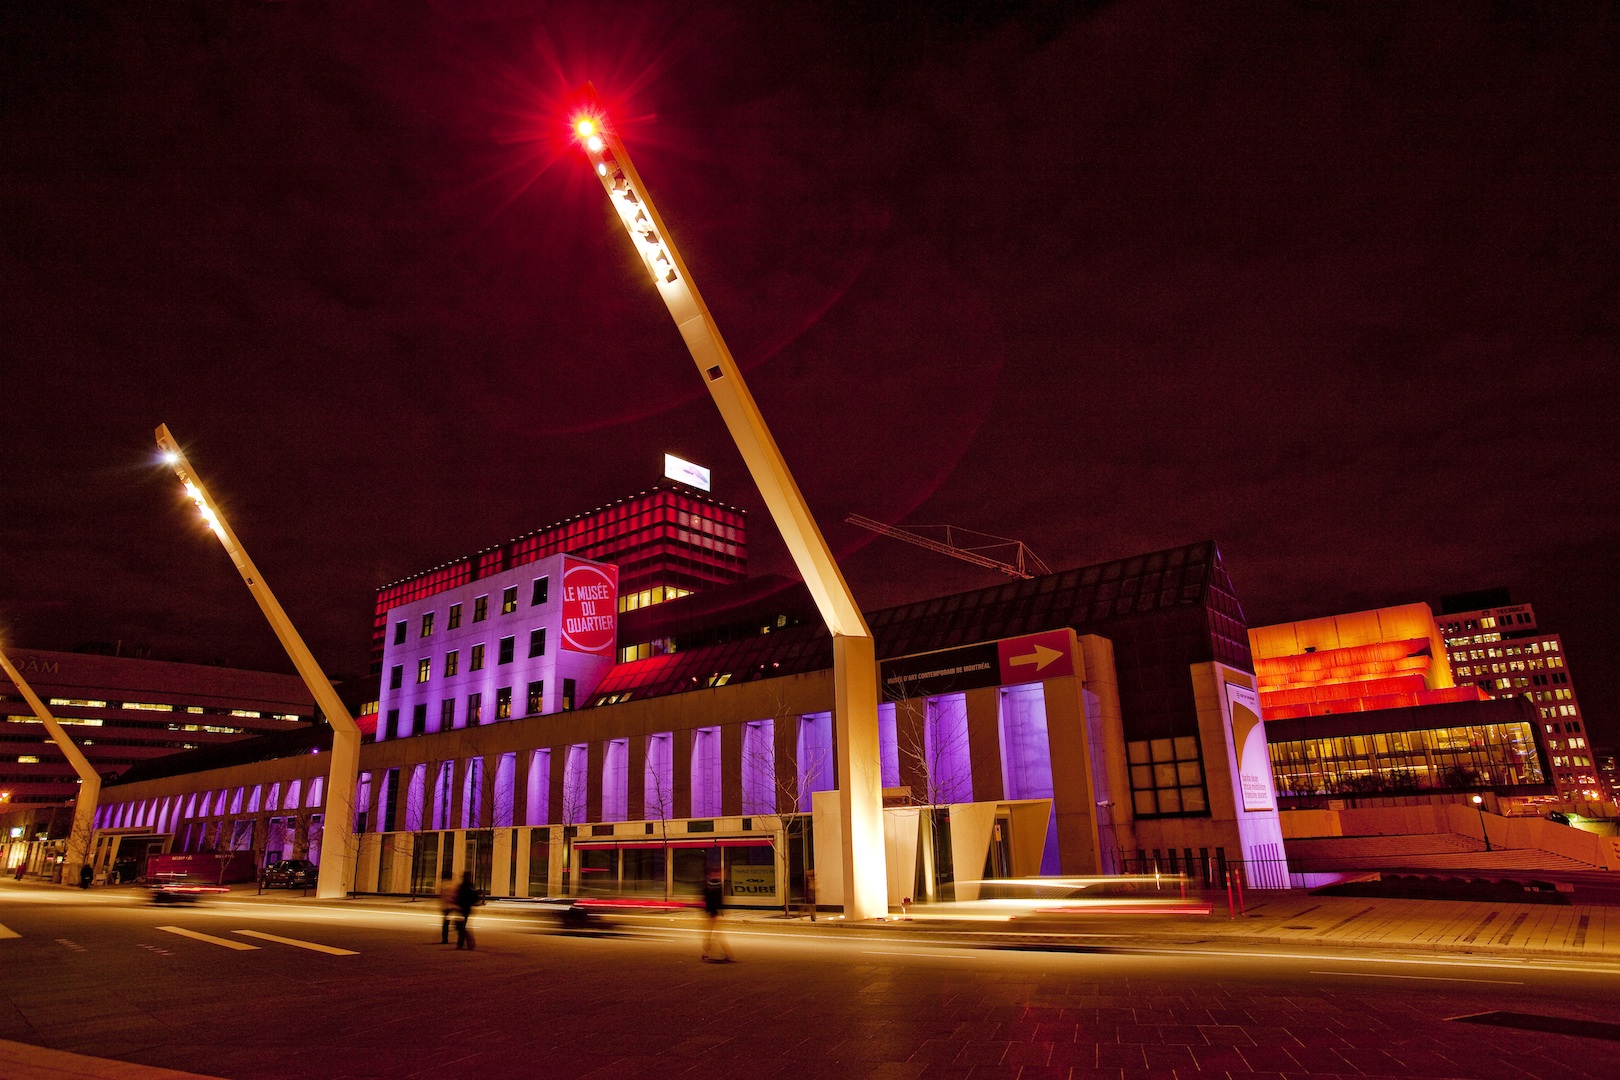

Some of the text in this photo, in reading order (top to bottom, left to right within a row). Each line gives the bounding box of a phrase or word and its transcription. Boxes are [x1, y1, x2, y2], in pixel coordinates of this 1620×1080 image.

[563, 582, 610, 602] LE MUSÉE
[581, 601, 596, 617] DU
[566, 615, 614, 634] QUARTIER
[955, 666, 963, 674] DE
[963, 661, 991, 673] MONTRÉAL
